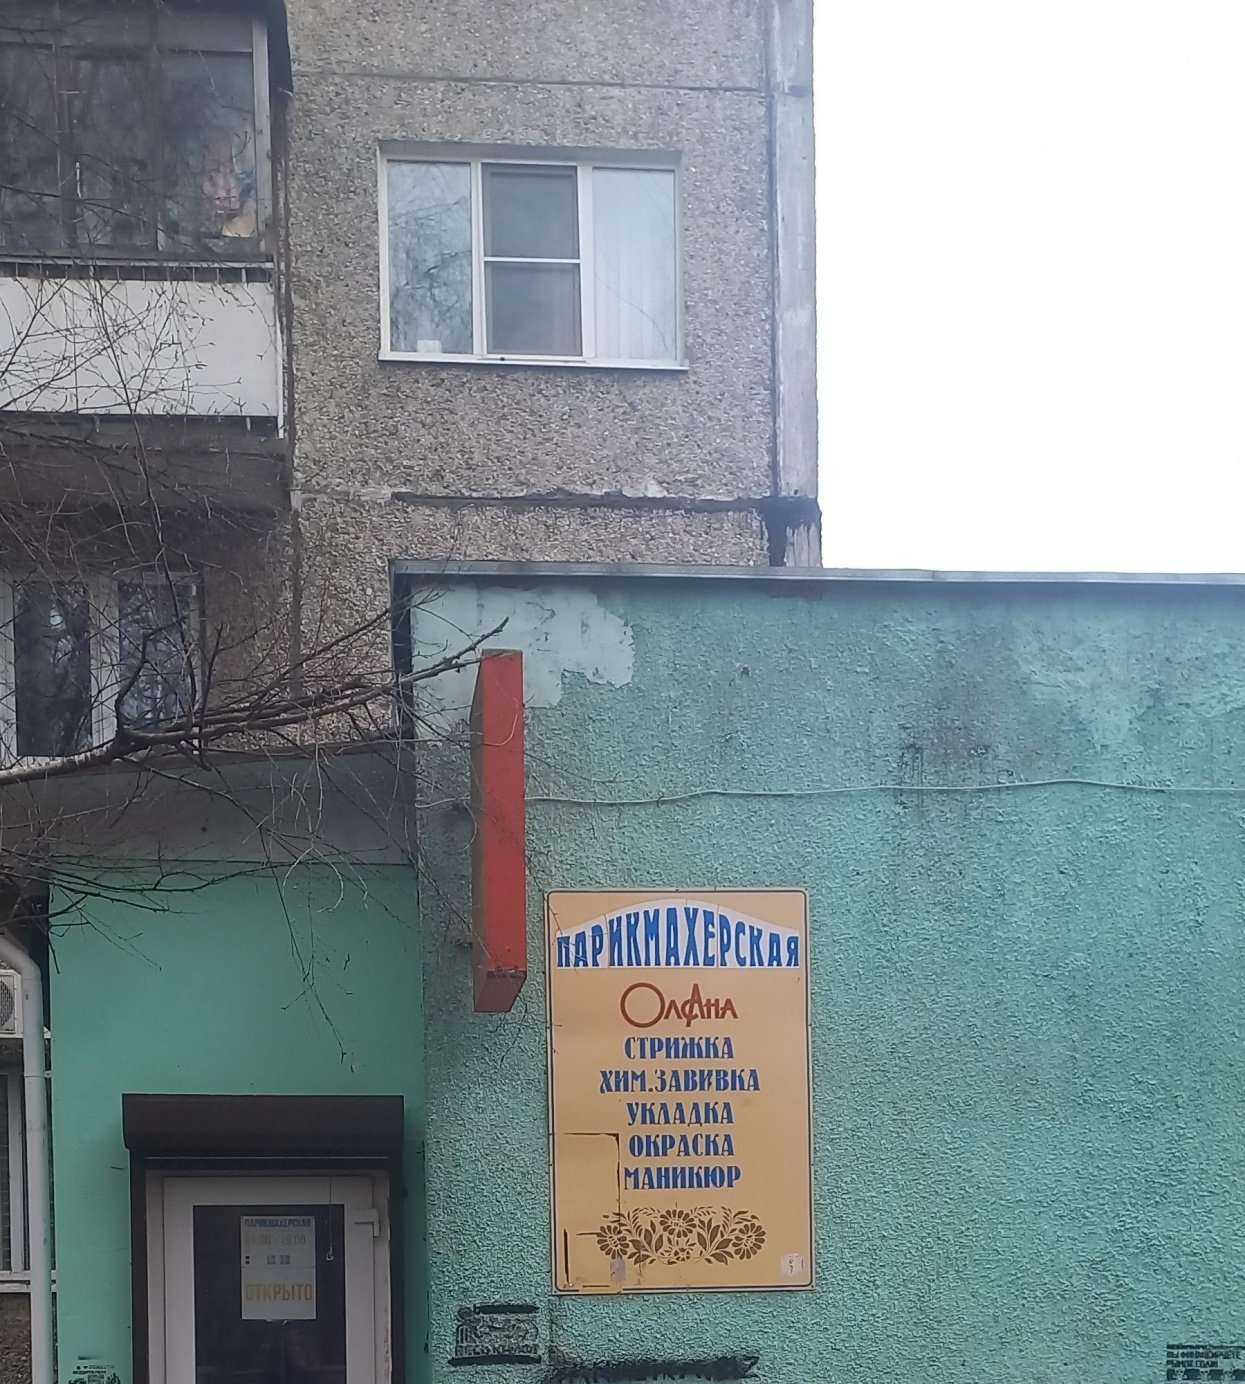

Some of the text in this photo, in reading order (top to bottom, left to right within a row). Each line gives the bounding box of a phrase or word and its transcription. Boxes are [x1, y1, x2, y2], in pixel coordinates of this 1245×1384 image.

[556, 906, 800, 968] ПАРИКМАХЕРСКАЯ
[624, 1036, 735, 1060] СТРИЖКА
[600, 1068, 760, 1093] ХИМ.ЗАВИВКА
[626, 1101, 735, 1128] УКЛАДКА
[628, 1133, 735, 1158] ОКРАСКА
[624, 1165, 742, 1191] МАНИКЮР
[246, 1283, 313, 1302] ОТКРЫТО
